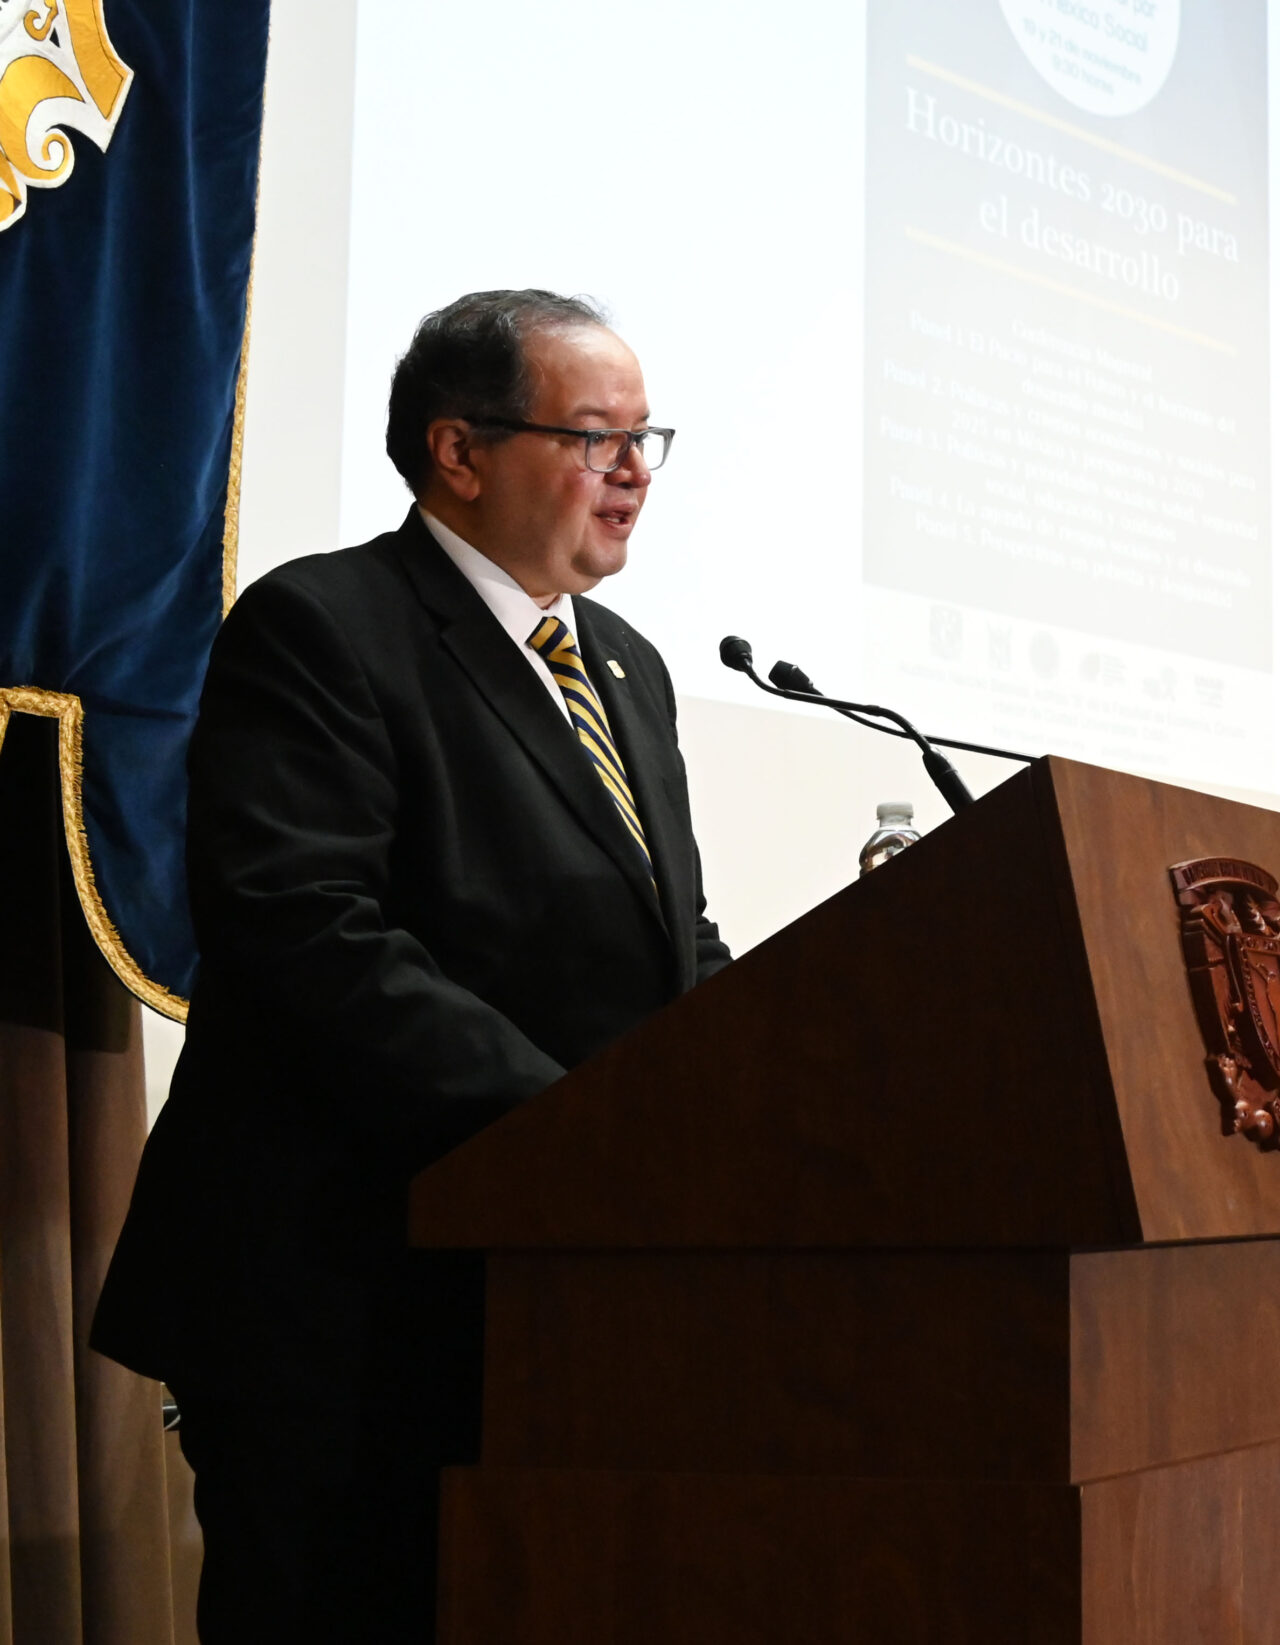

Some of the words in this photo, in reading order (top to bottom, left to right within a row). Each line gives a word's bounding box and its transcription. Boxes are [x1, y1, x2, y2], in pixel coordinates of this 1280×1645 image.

[1104, 13, 1149, 53] Social
[905, 87, 1092, 204] Horizontes
[1101, 182, 1168, 236] 2030
[1177, 212, 1239, 263] para
[980, 194, 1008, 239] el
[1020, 206, 1180, 303] desarrollo
